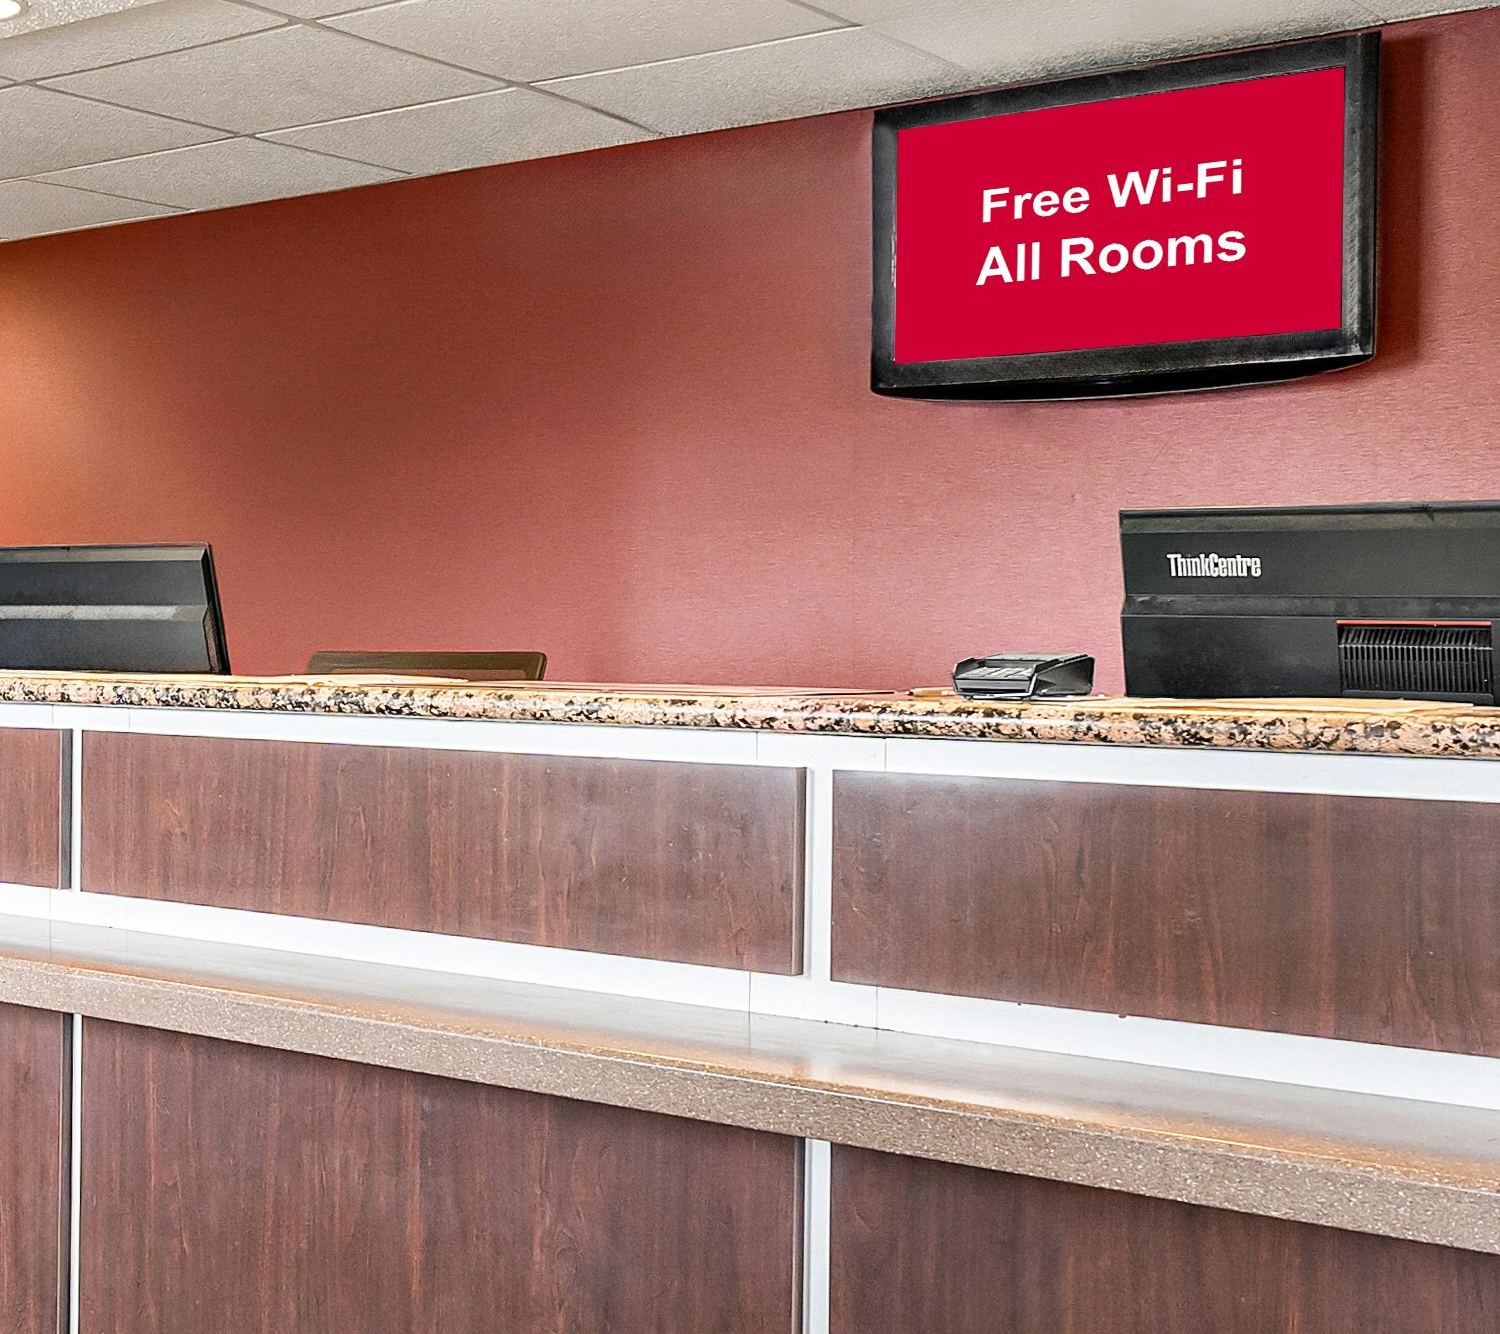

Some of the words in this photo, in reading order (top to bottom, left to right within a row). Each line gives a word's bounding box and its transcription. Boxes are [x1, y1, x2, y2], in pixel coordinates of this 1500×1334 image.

[981, 185, 1091, 223] Free
[1106, 159, 1243, 208] Wi-Fi
[975, 240, 1042, 286] All
[1059, 229, 1248, 278] Rooms
[1166, 552, 1262, 578] ThinkCentre
